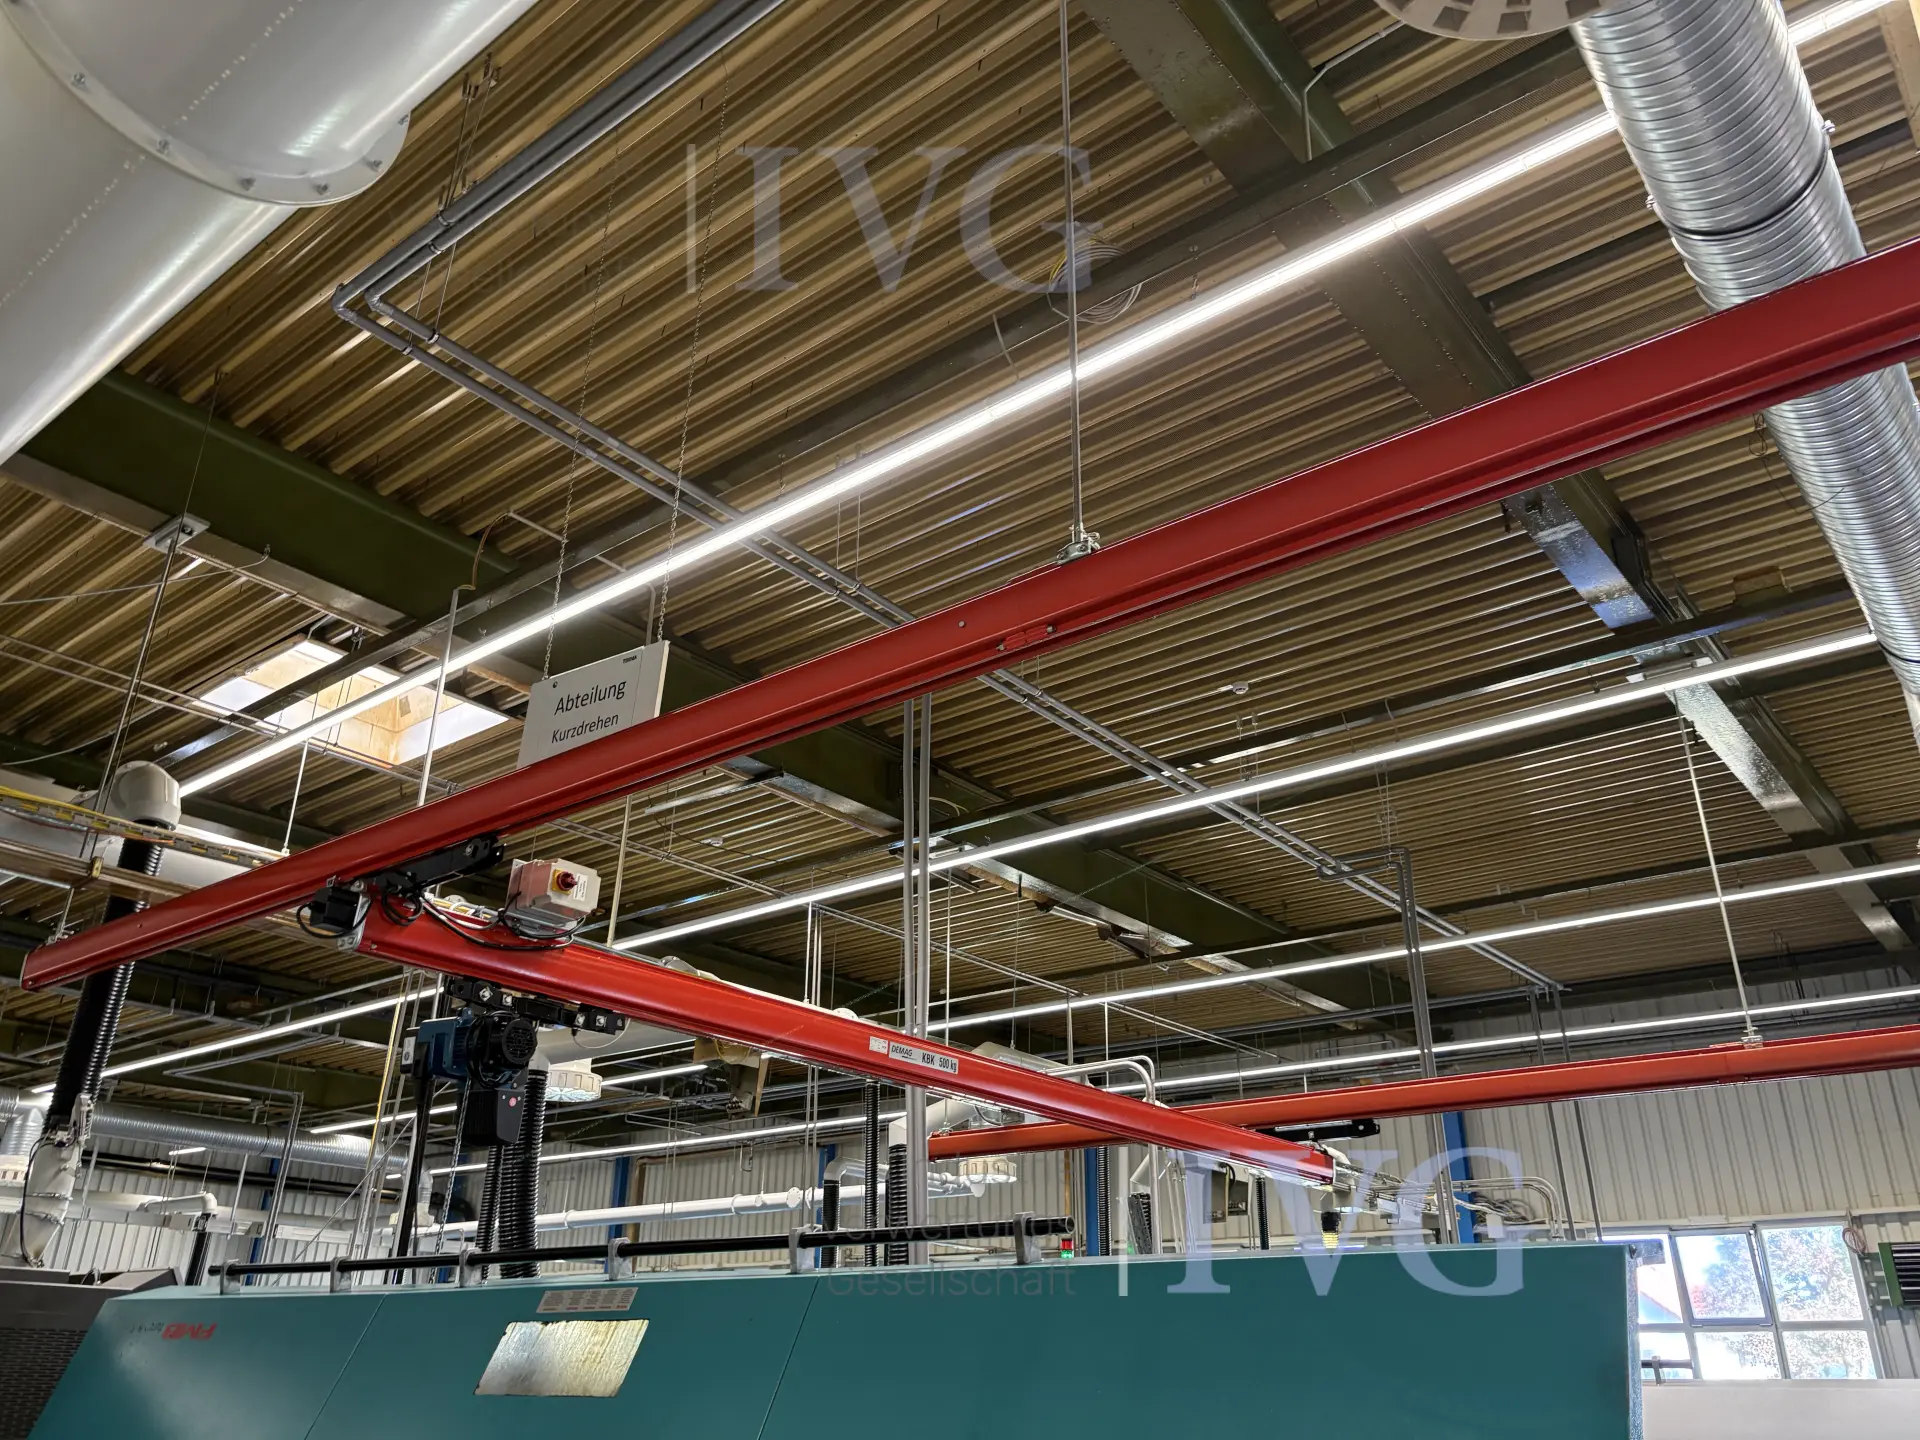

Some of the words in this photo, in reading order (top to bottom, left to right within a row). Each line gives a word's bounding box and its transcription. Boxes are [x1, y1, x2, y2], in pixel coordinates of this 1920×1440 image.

[554, 681, 627, 716] Abteilung
[551, 714, 619, 744] Kurzdrehen
[891, 1044, 913, 1057] DEMAG
[921, 1052, 935, 1066] KBK
[939, 1057, 950, 1070] 500
[950, 1060, 957, 1073] kg
